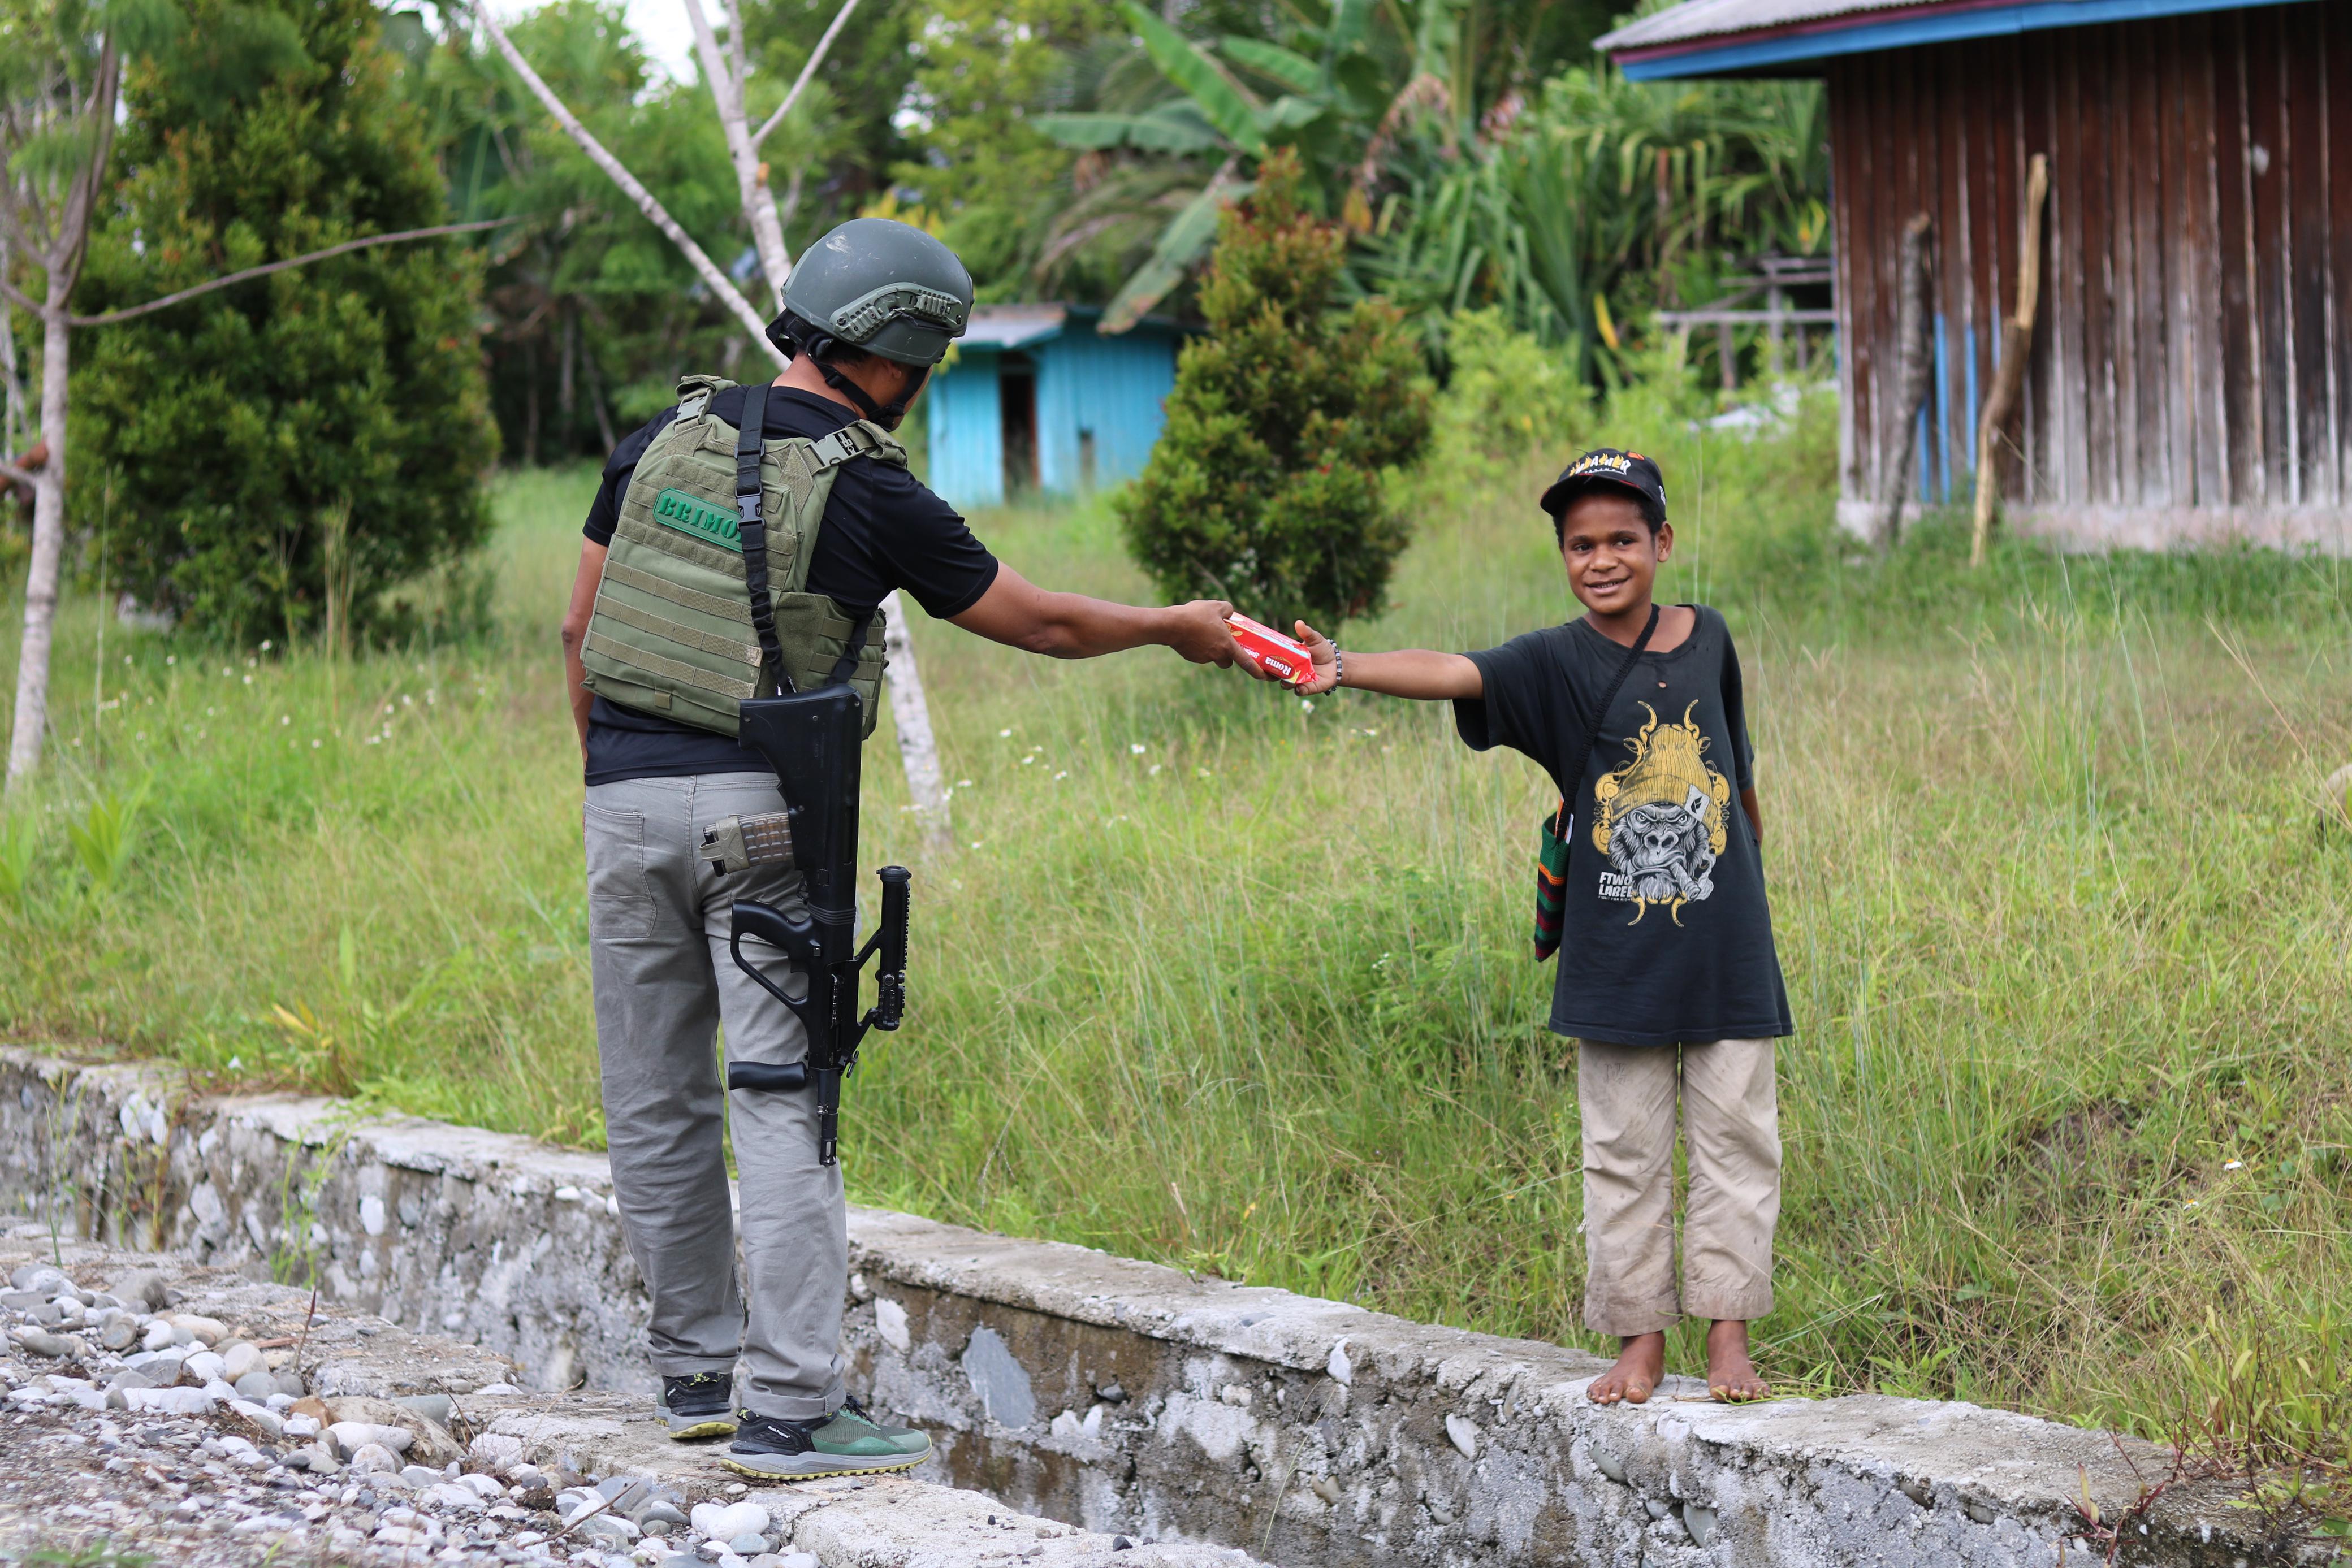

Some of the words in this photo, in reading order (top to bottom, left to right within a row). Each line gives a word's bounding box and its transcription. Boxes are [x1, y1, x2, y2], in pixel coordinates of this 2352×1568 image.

[658, 495, 742, 543] BRIMO
[1265, 656, 1292, 676] Roma
[1599, 872, 1633, 886] FTWO
[1599, 884, 1632, 898] LABEL
